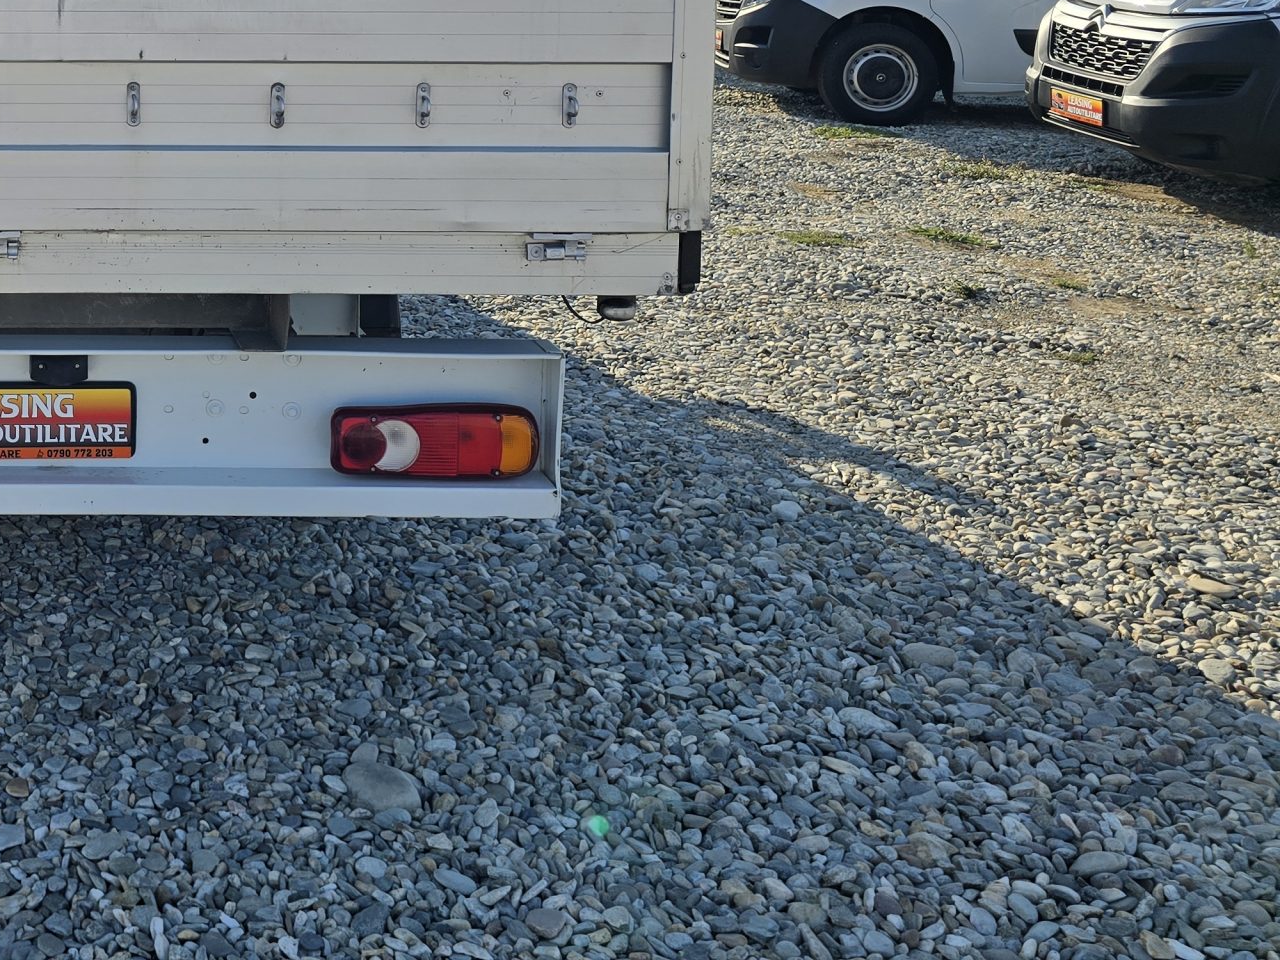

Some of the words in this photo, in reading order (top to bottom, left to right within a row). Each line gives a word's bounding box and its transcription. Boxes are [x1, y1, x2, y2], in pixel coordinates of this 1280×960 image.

[1067, 95, 1093, 109] LEASING
[46, 449, 71, 458] 0790
[74, 449, 91, 458] 772
[95, 449, 113, 458] 203
